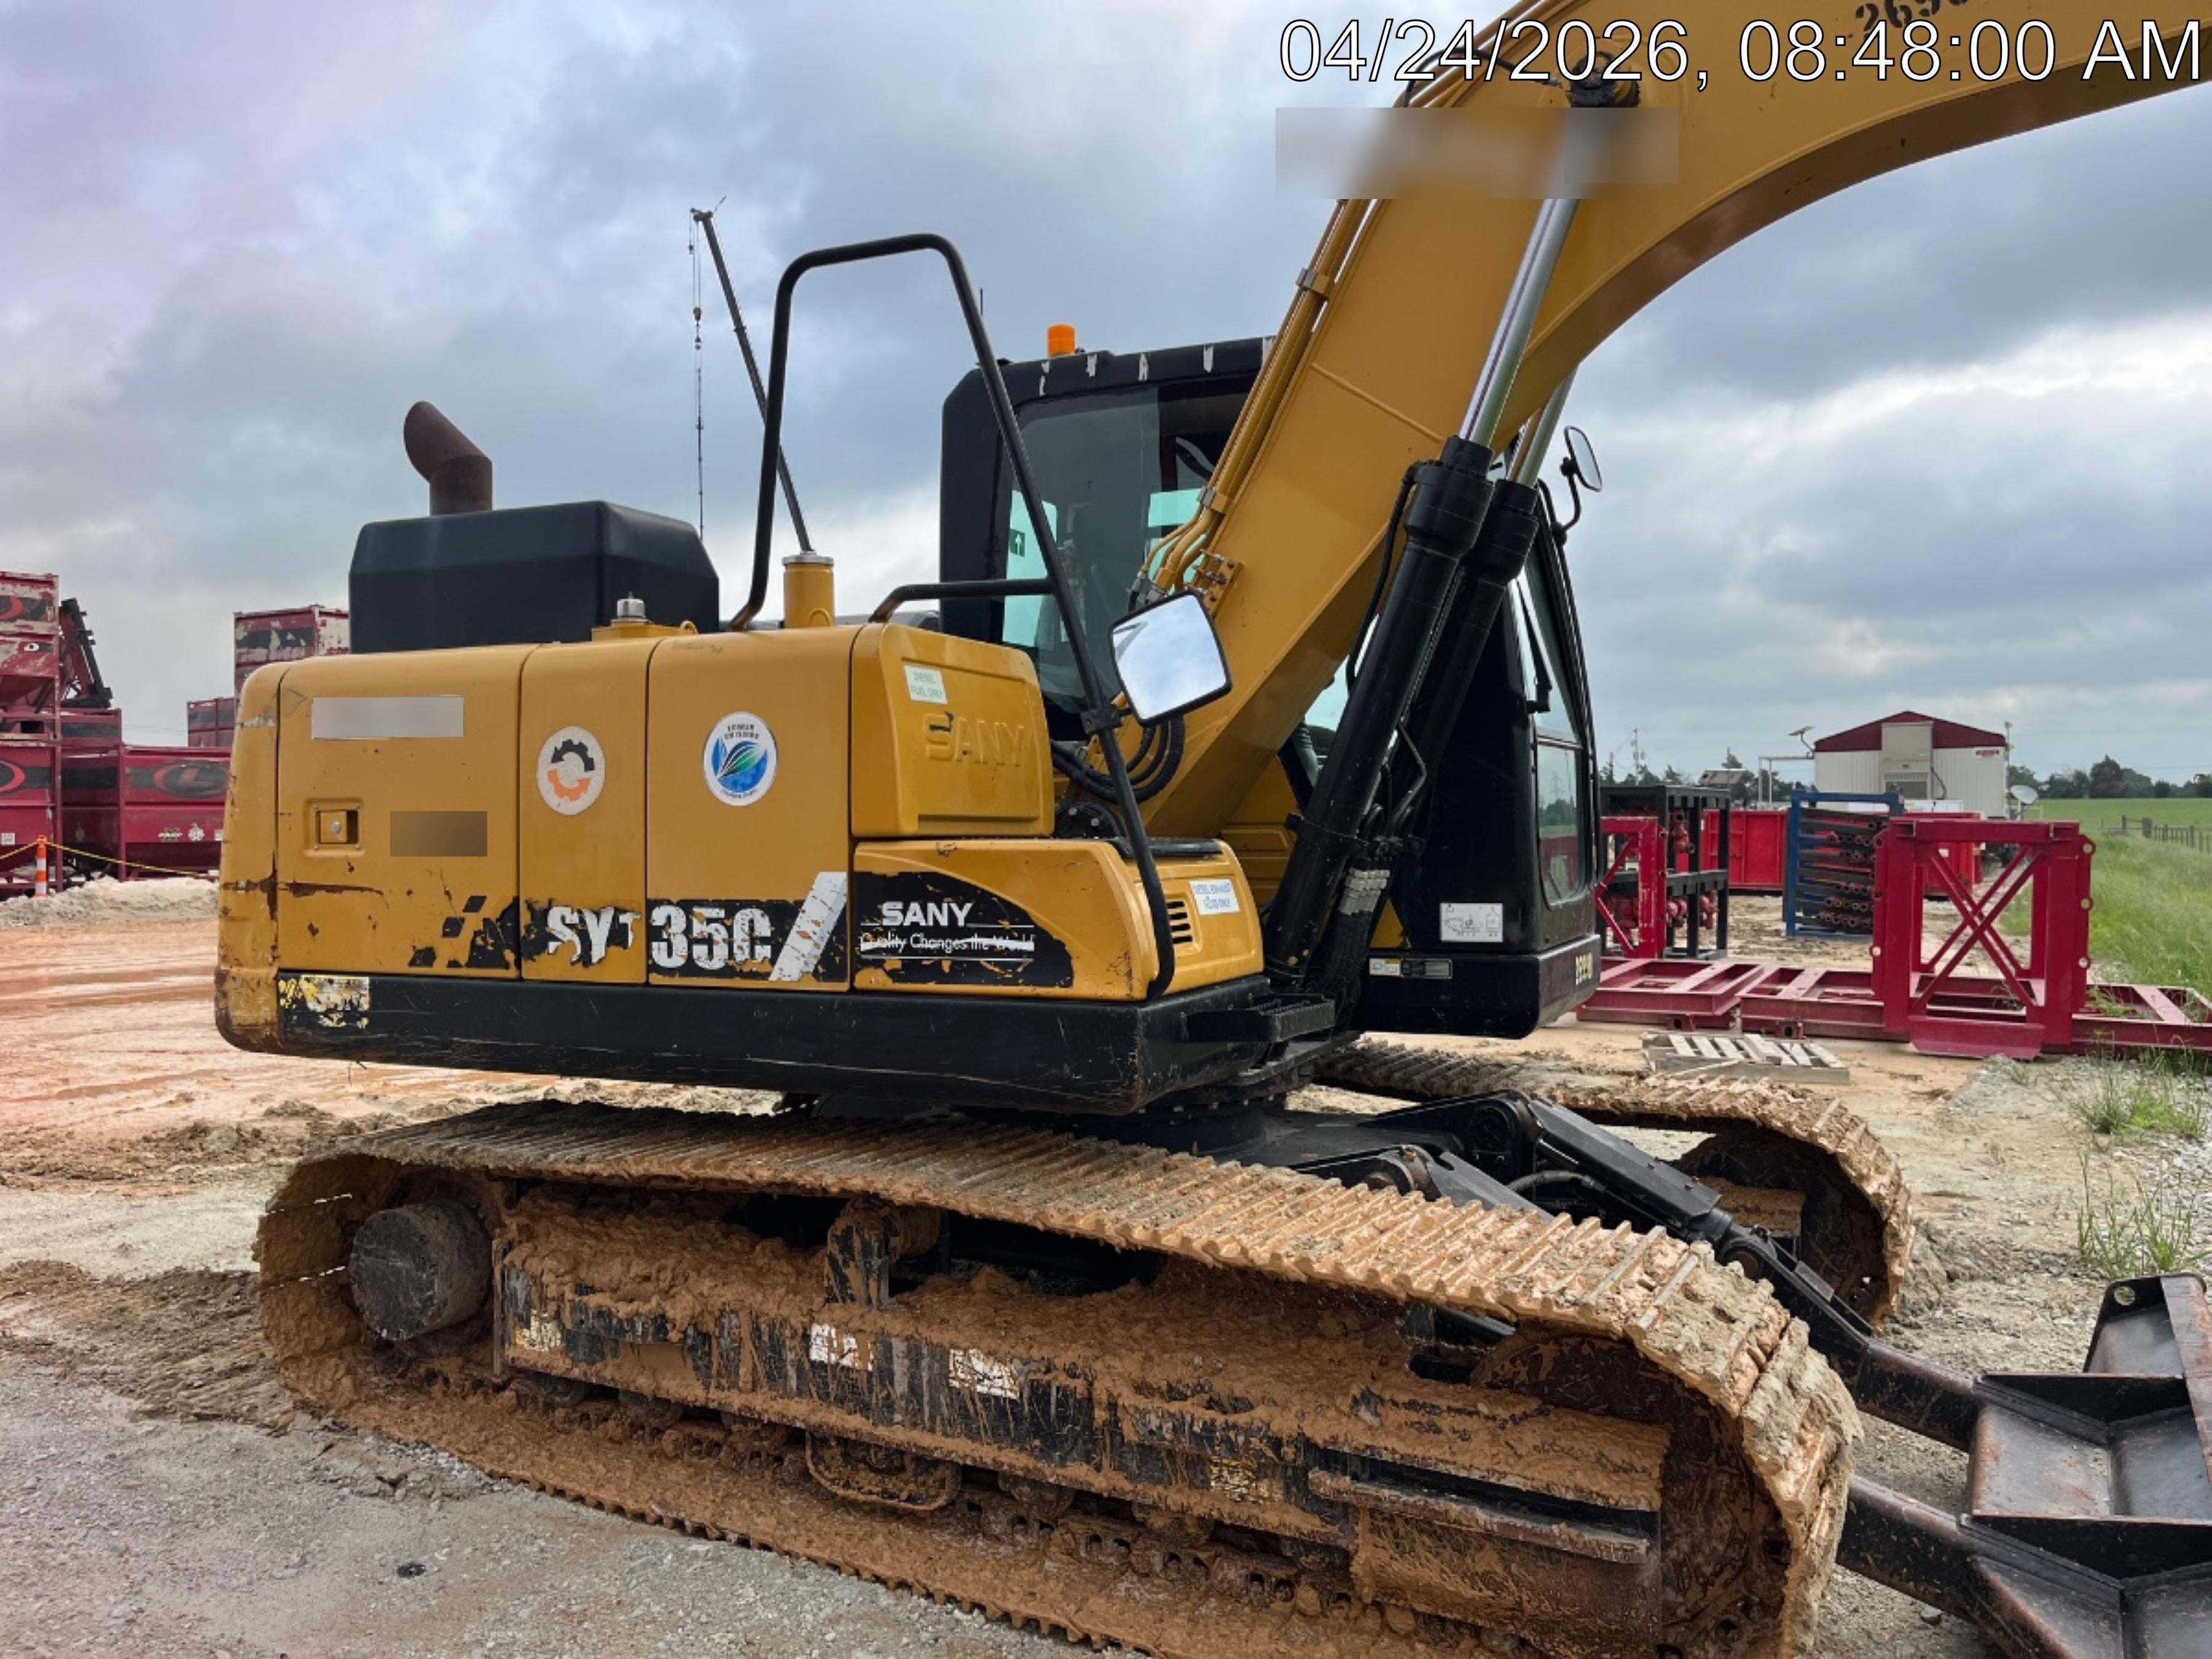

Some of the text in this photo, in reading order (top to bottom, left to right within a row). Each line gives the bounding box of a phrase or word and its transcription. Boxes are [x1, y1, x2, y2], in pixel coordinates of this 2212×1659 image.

[1855, 0, 1969, 42] 26
[923, 712, 1024, 767] SANY
[882, 901, 973, 927] SANY
[910, 931, 967, 953] Changes
[992, 933, 1035, 951] Wld
